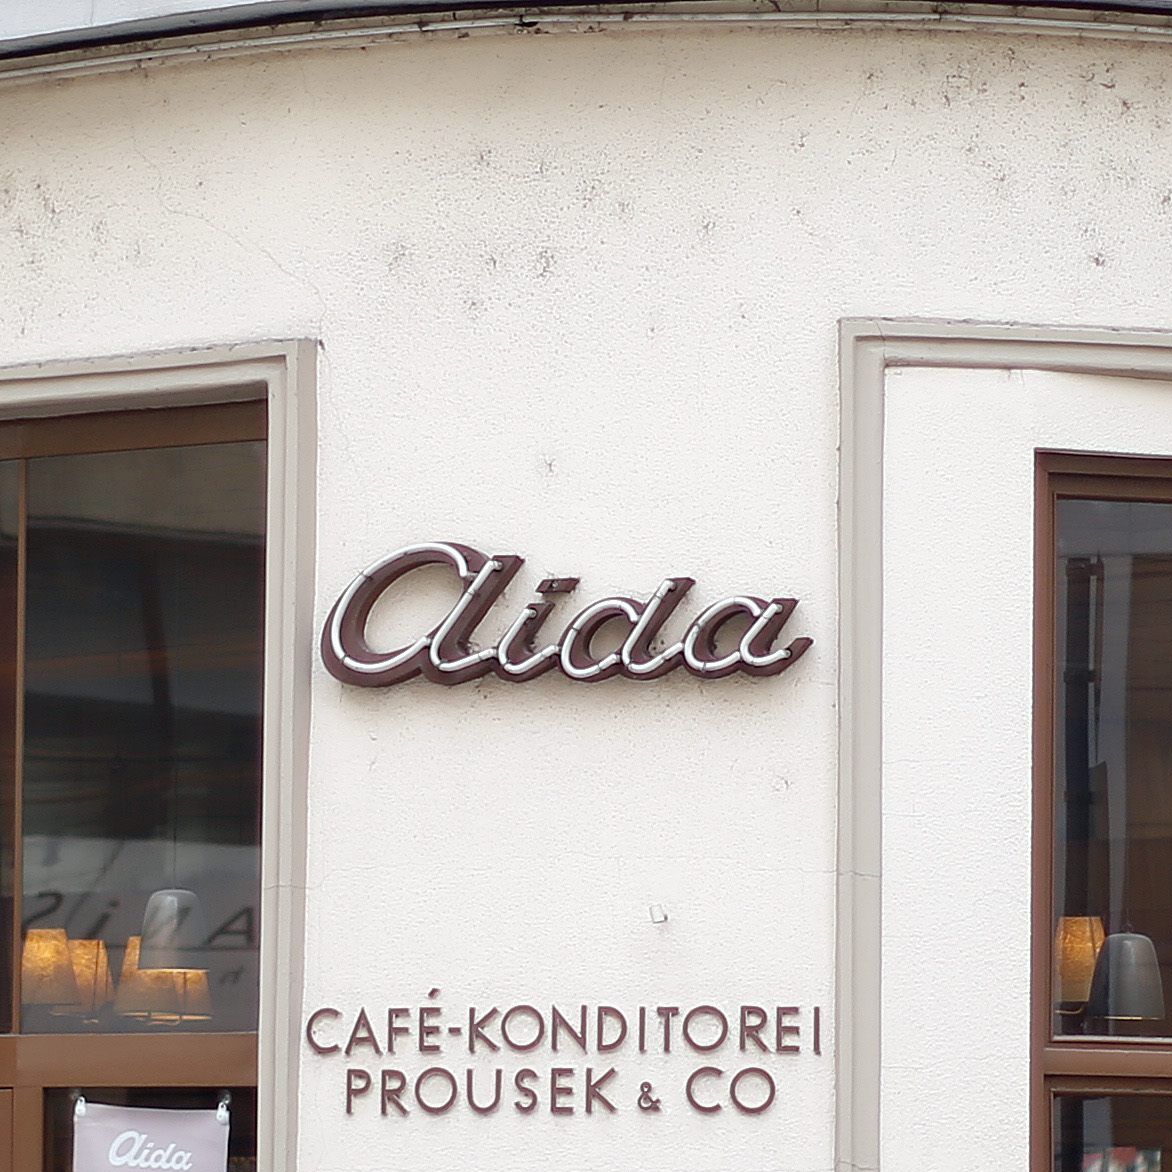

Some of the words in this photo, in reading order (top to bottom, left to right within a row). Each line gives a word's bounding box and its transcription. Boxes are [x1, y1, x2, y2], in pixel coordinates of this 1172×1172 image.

[320, 541, 815, 688] Aida
[306, 987, 822, 1056] CAFÉ-KONDITOREI
[346, 1066, 618, 1116] PROUSEK
[637, 1081, 662, 1111] &
[685, 1065, 776, 1114] CO
[108, 1131, 193, 1171] Aida
